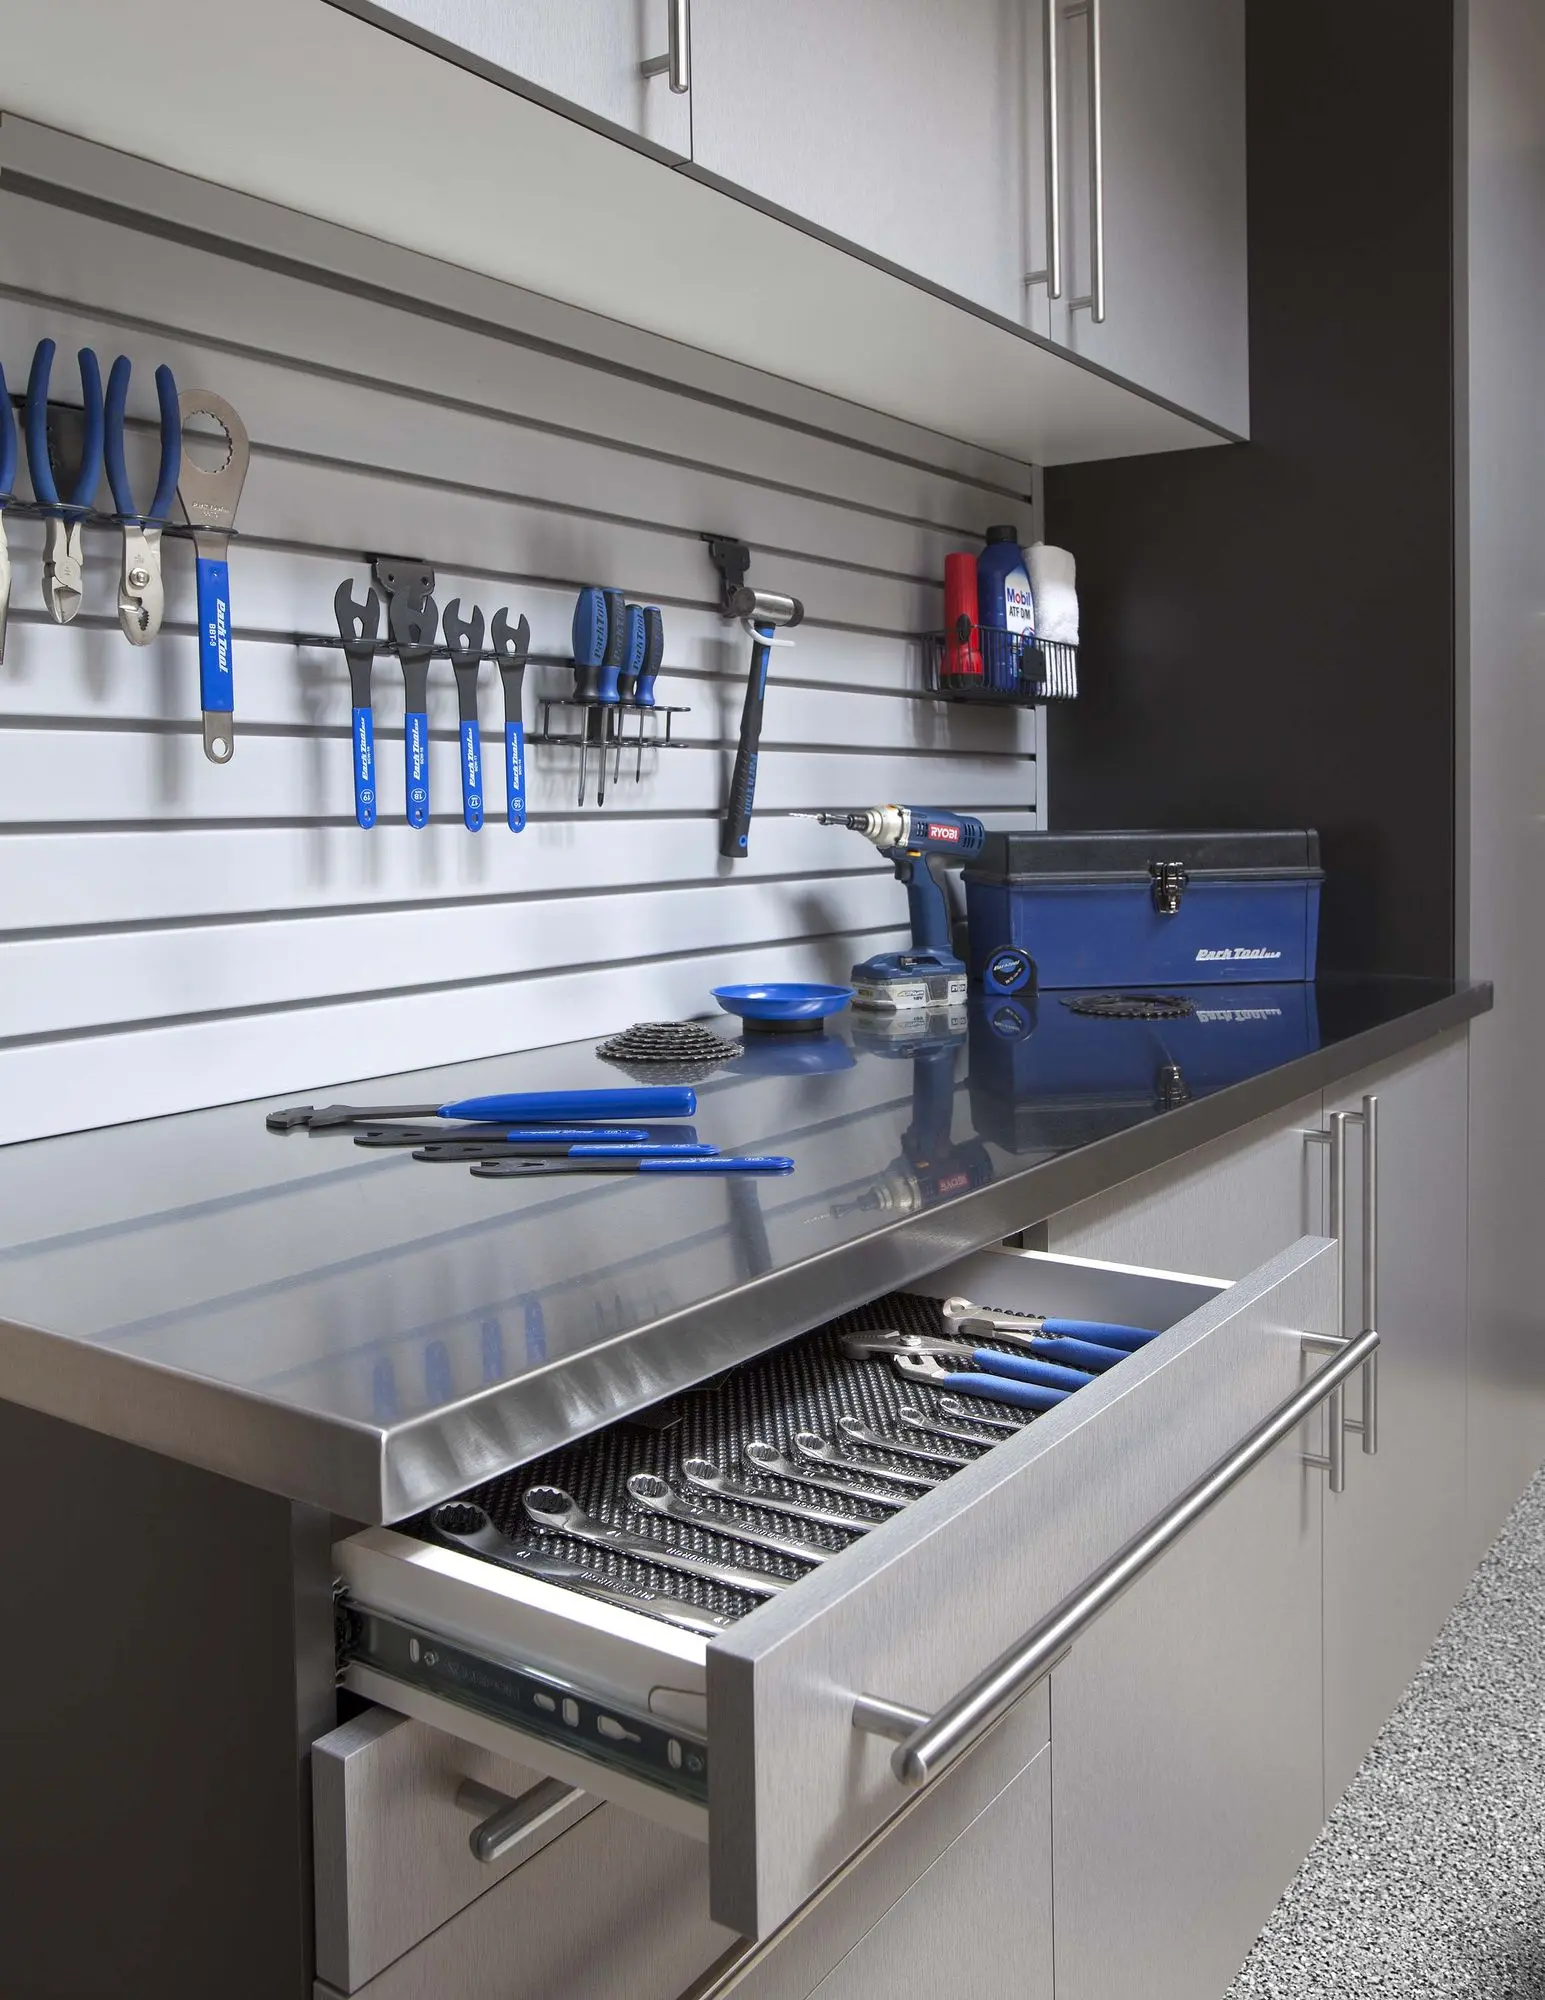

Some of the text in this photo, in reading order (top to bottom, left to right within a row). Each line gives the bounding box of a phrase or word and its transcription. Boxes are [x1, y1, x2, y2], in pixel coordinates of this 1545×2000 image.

[1007, 587, 1031, 606] Mobil
[1009, 606, 1019, 617] ATF
[930, 826, 958, 840] RYOBI
[1196, 949, 1233, 961] Park
[1233, 948, 1266, 959] Tool
[792, 1500, 856, 1519] PITTSBURGH
[738, 1523, 805, 1546] PITTSBURGH
[581, 1571, 655, 1600] PITTSBURGH
